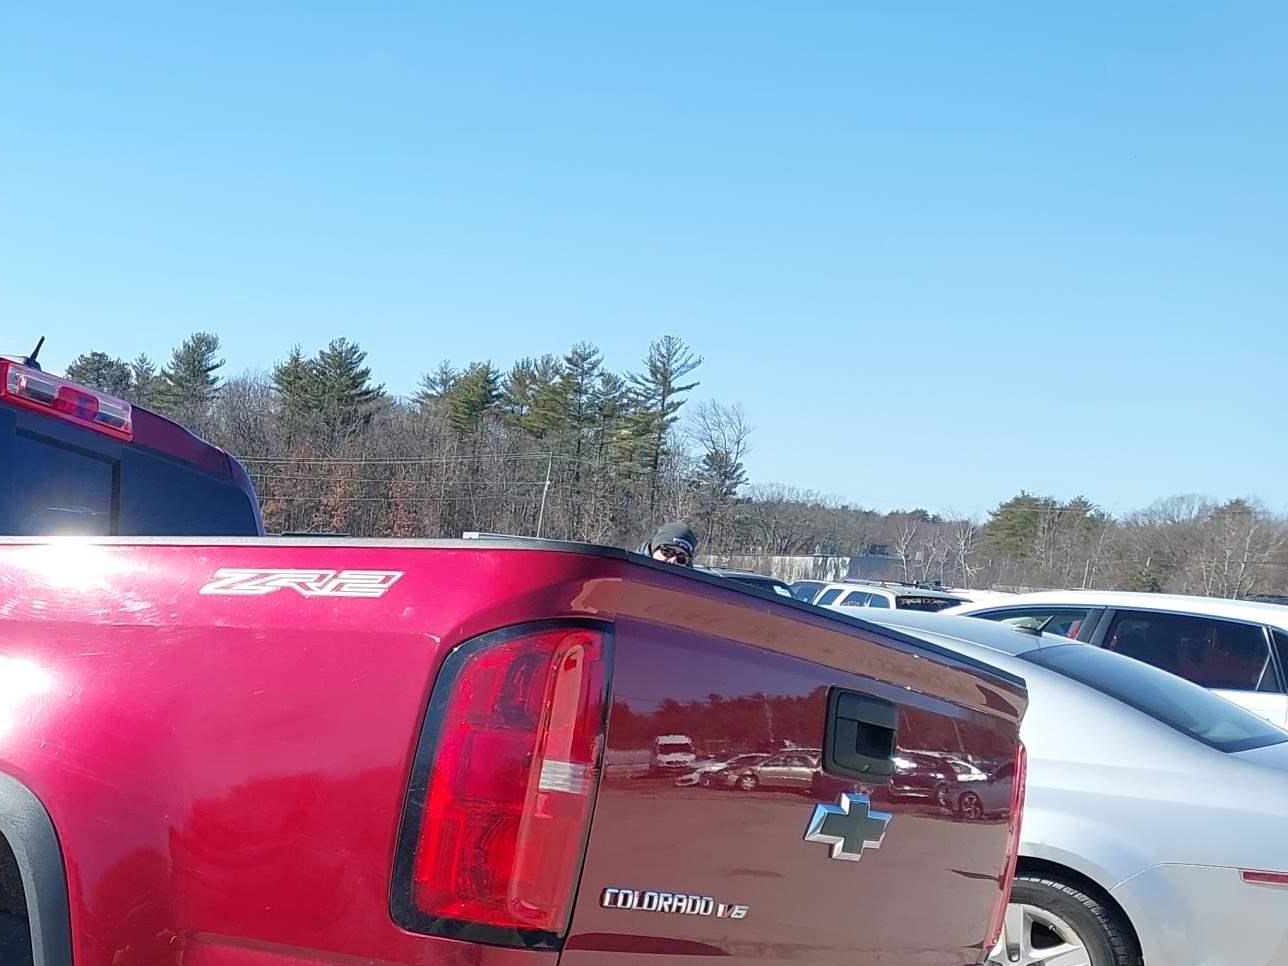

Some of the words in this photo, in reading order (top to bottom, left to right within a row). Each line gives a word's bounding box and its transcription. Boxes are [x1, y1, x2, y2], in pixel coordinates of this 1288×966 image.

[198, 567, 405, 599] ZR2
[601, 887, 714, 916] COLORADO
[716, 903, 750, 919] V6
